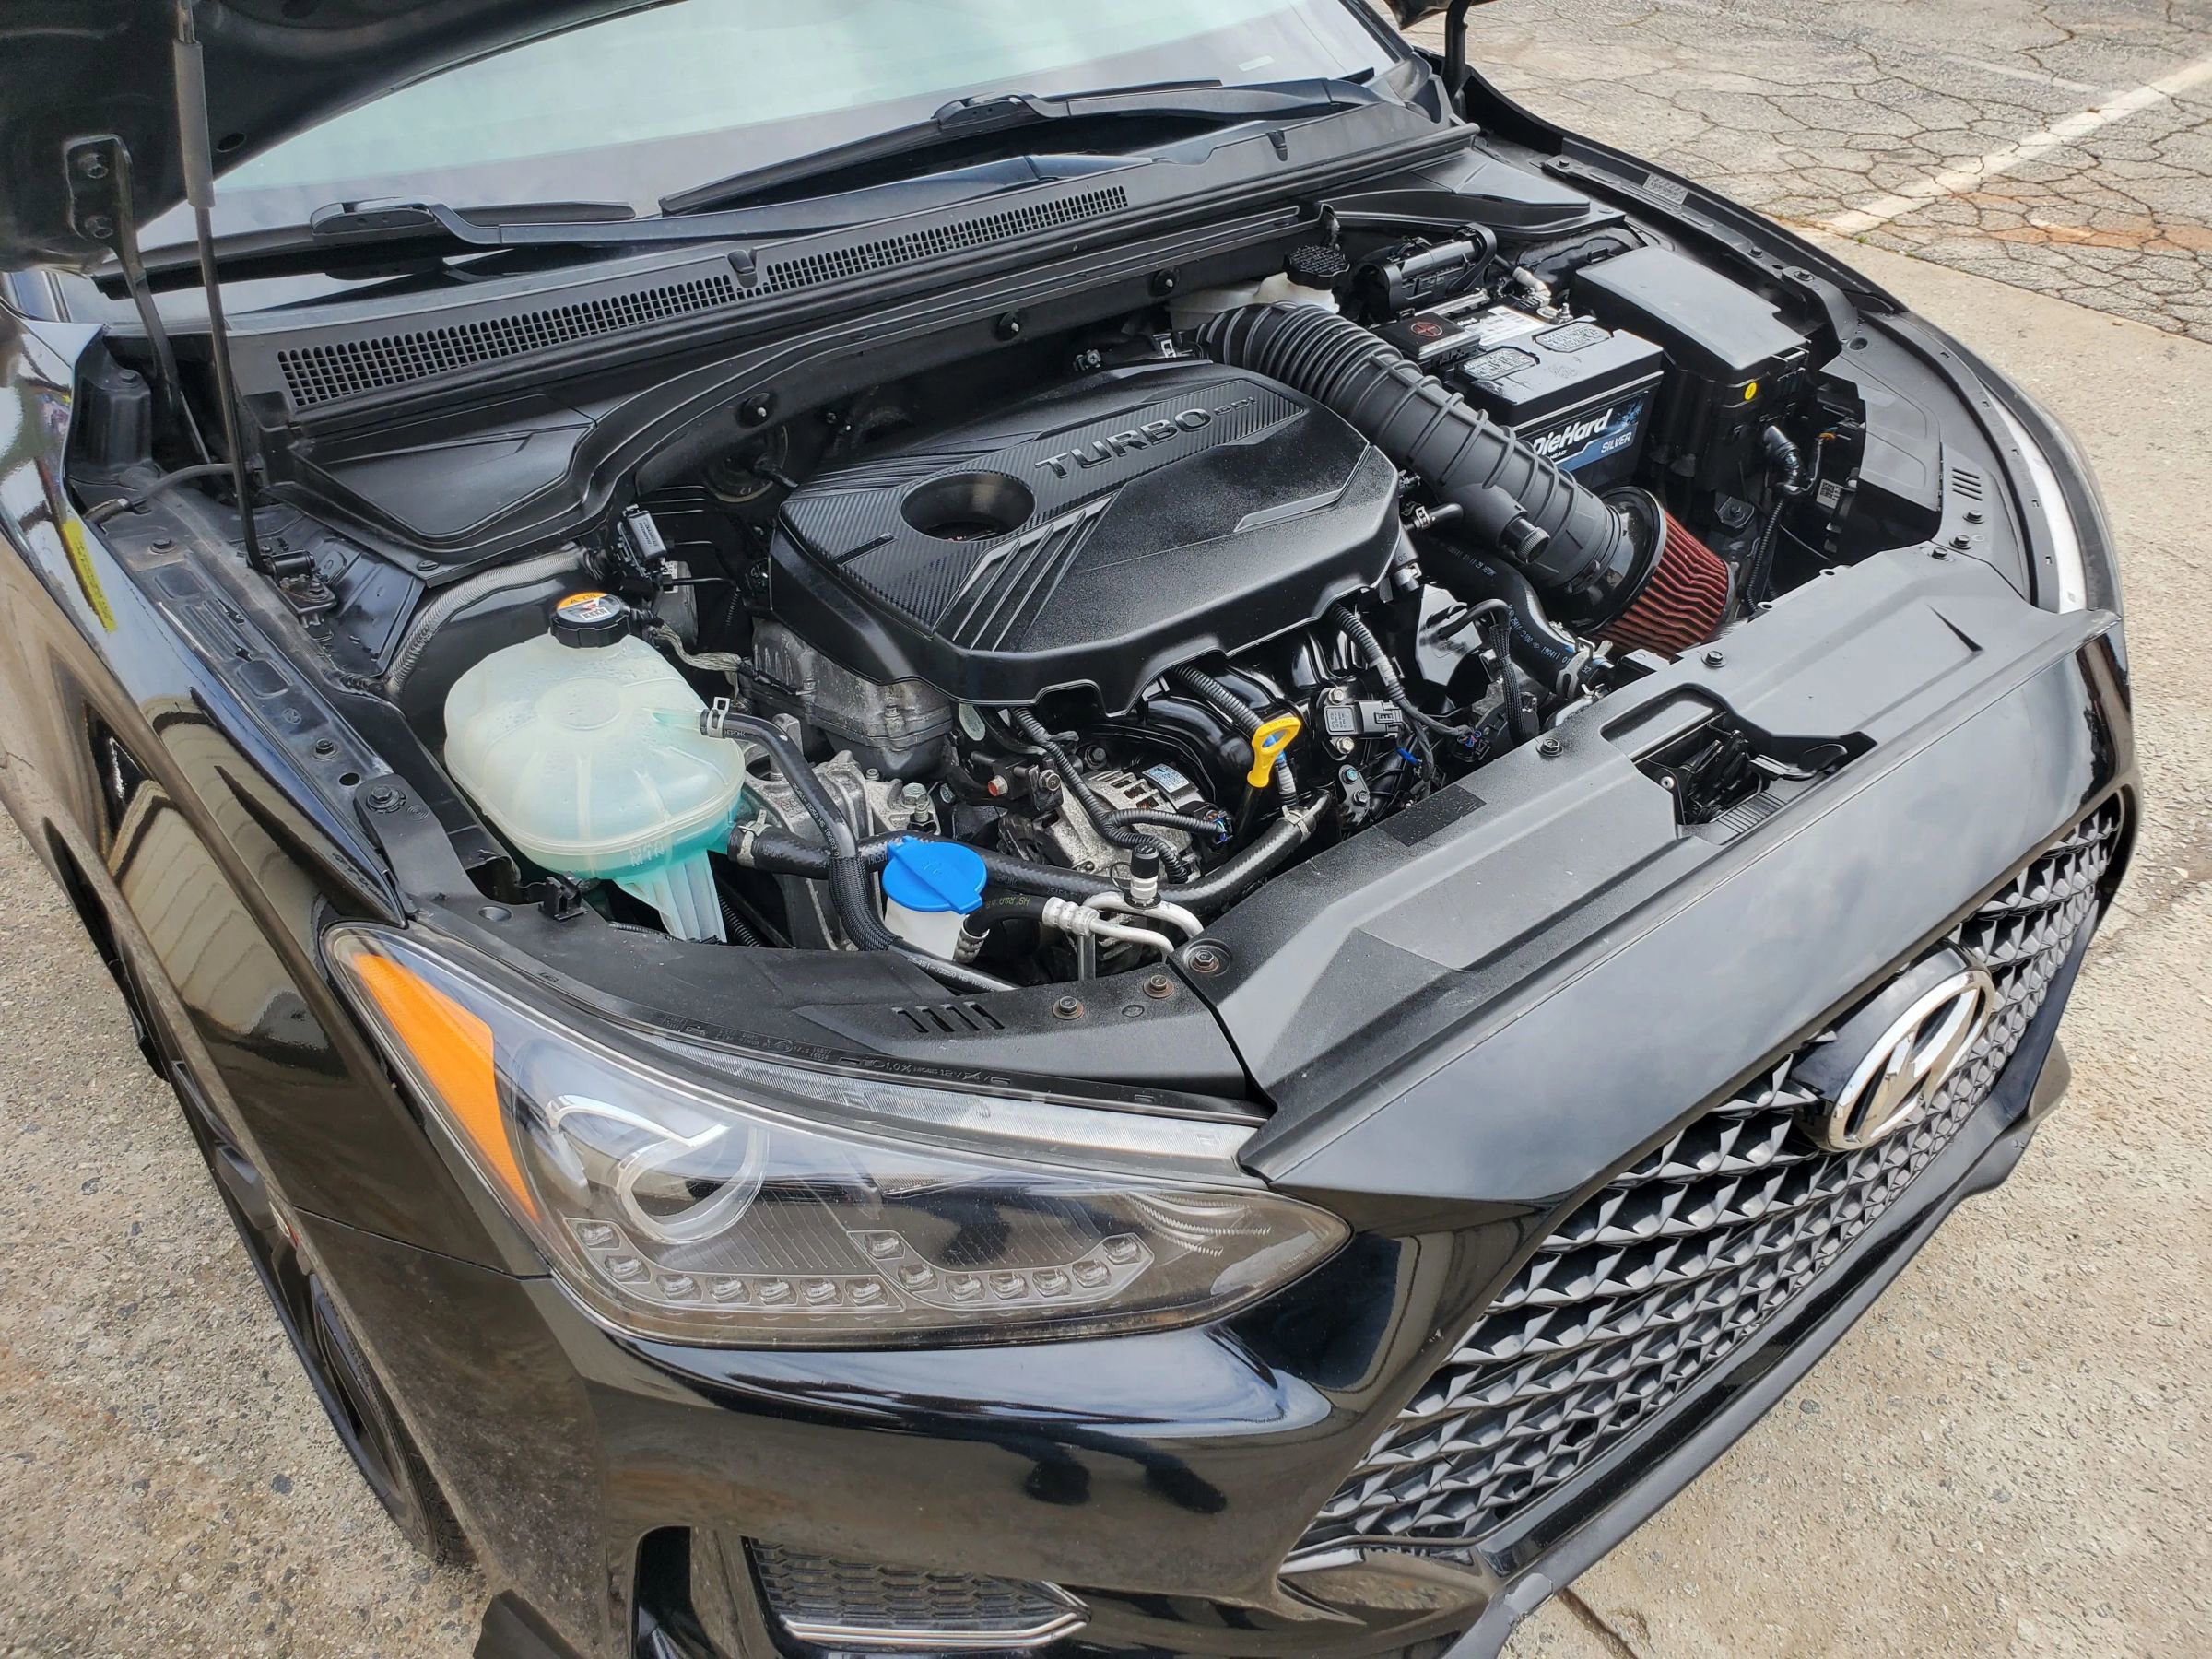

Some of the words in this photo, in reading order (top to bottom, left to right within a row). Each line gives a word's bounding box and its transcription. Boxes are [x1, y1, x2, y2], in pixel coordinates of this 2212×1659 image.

[1034, 407, 1213, 479] TURBO
[1533, 407, 1614, 456] DieHard
[1601, 431, 1632, 453] SILVER
